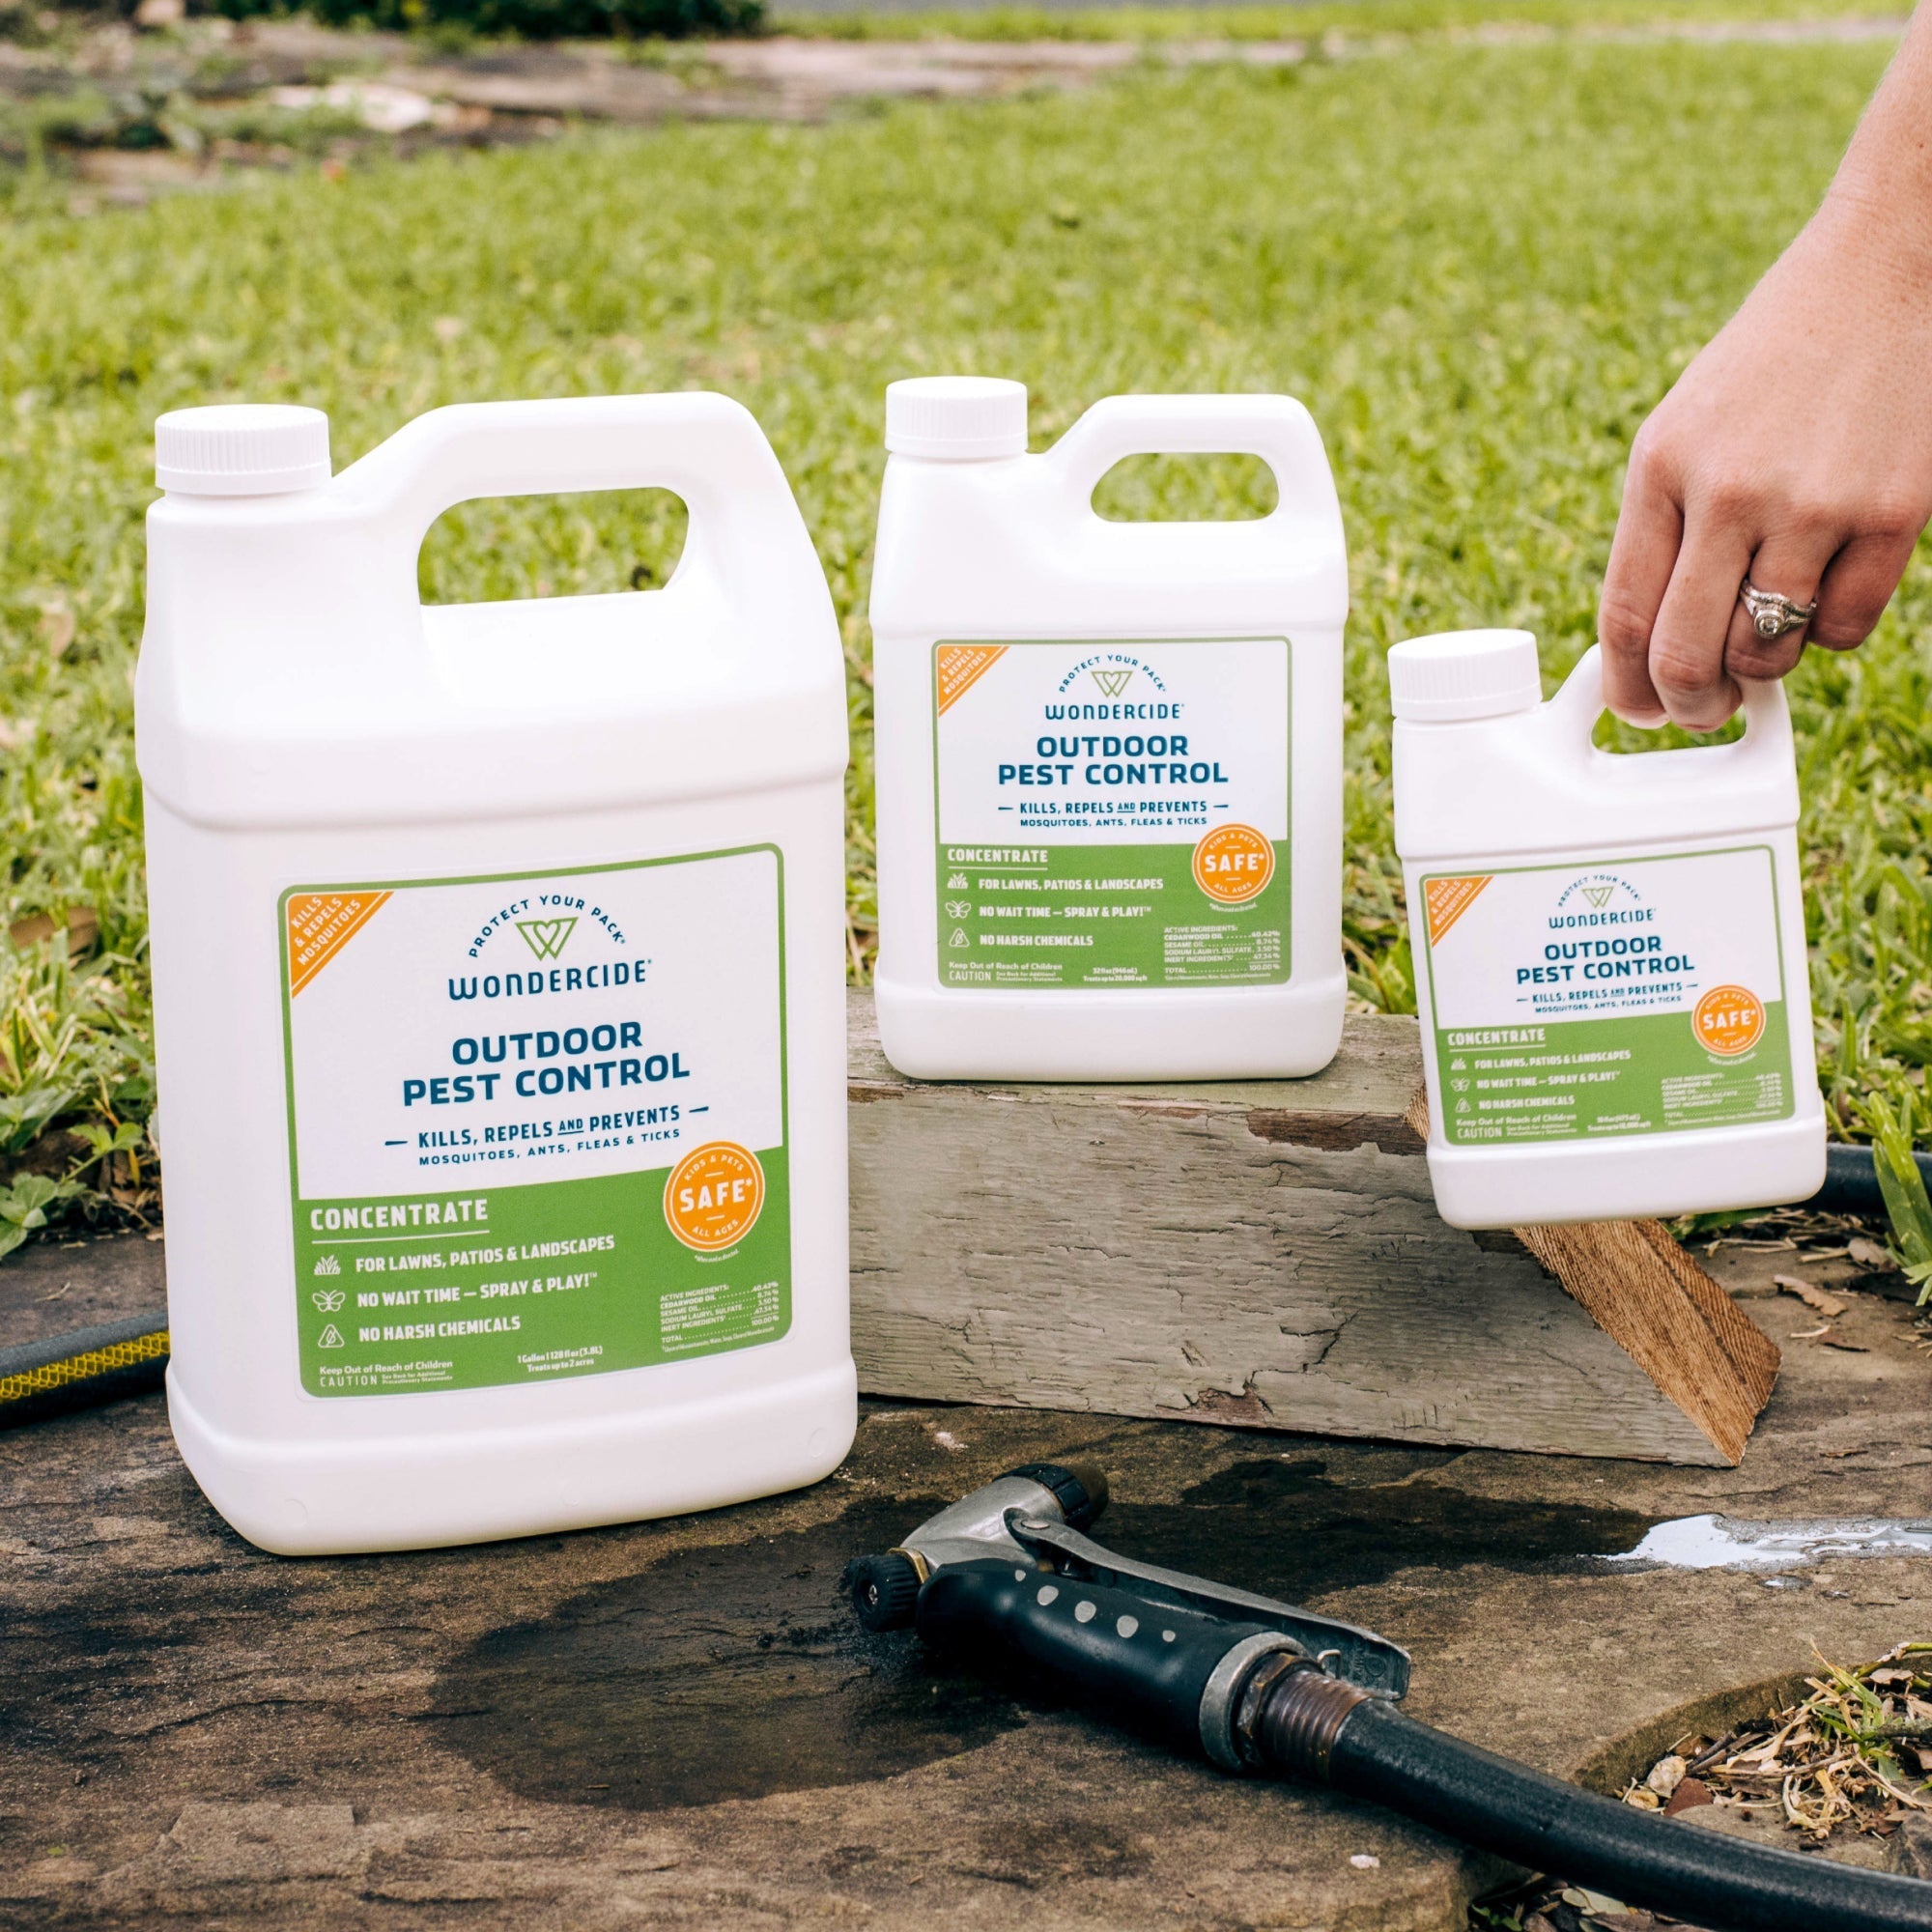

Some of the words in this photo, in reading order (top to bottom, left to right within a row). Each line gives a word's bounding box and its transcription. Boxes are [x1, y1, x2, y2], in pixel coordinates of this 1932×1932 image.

[1059, 656, 1100, 693] PROTECT
[1107, 655, 1138, 666] YOUR
[1037, 735, 1189, 758] OUTDOOR
[999, 764, 1073, 785] PEST
[1085, 762, 1229, 785] CONTROL
[1020, 802, 1061, 815] KILLS,
[1065, 802, 1114, 813] REPELS
[1118, 802, 1135, 810] AND
[1140, 801, 1208, 812] PREVENTS
[1020, 818, 1093, 828] MOSQUITOES,
[1095, 818, 1127, 827] ANTS,
[1131, 817, 1162, 826] FLEAS
[1167, 817, 1173, 826] &
[948, 848, 1048, 863] CONCENTRATE
[979, 879, 999, 890] FOR
[1001, 879, 1041, 891] LAWNS,
[1044, 879, 1082, 890] PATIOS
[1084, 879, 1093, 890] &
[1094, 878, 1163, 890] LANDSCAPES
[1214, 883, 1229, 893] ALL
[291, 896, 323, 928] KILLS
[980, 906, 995, 917] NO
[997, 906, 1023, 917] WAIT
[1025, 906, 1051, 917] TIME
[1065, 906, 1099, 918] SPRAY
[1101, 906, 1110, 917] &
[294, 937, 305, 948] &
[303, 897, 342, 937] REPELS
[469, 899, 529, 958] PROTECT
[539, 895, 585, 910] YOUR
[298, 899, 360, 965] MOSQUITOES
[980, 935, 995, 945] NO
[997, 935, 1033, 945] HARSH
[1035, 935, 1094, 946] CHEMICALS
[1545, 935, 1662, 961] OUTDOOR
[950, 971, 991, 980] CAUTION
[1517, 965, 1575, 984] PEST
[1584, 954, 1694, 980] CONTROL
[1532, 992, 1566, 1003] KILLS,
[1569, 989, 1607, 1001] REPELS
[1629, 981, 1682, 995] PREVENTS
[1659, 995, 1682, 1004] TICKS
[452, 1021, 642, 1065] OUTDOOR
[1447, 1028, 1546, 1046] CONCENTRATE
[1475, 1060, 1492, 1069] FOR
[1494, 1057, 1528, 1068] LAWNS,
[1530, 1054, 1562, 1066] PATIOS
[1572, 1050, 1631, 1064] LANDSCAPES
[404, 1073, 500, 1107] PEST
[516, 1053, 690, 1096] CONTROL
[1477, 1079, 1490, 1089] NO
[1492, 1077, 1514, 1088] WAIT
[1516, 1076, 1537, 1087] TIME
[1548, 1073, 1577, 1085] SPRAY
[1479, 1099, 1492, 1110] NO
[1493, 1097, 1523, 1109] HARSH
[1524, 1094, 1575, 1107] CHEMICALS
[419, 1128, 478, 1148] KILLS,
[485, 1122, 553, 1144] REPELS
[558, 1119, 583, 1132] AND
[589, 1105, 680, 1131] PREVENTS
[1457, 1118, 1476, 1127] Keep
[1506, 1116, 1530, 1124] Reach
[1457, 1126, 1501, 1139] CAUTION
[419, 1149, 521, 1165] MOSQUITOES,
[527, 1144, 570, 1156] ANTS,
[578, 1137, 620, 1151] FLEAS
[626, 1136, 634, 1145] &
[641, 1129, 680, 1142] TICKS
[684, 1159, 706, 1180] KIDS
[721, 1154, 744, 1171] PETS
[310, 1199, 488, 1231] CONCENTRATE
[692, 1226, 710, 1236] ALL
[715, 1219, 738, 1236] AGES
[355, 1258, 385, 1273] FOR
[389, 1253, 446, 1271] LAWNS,
[450, 1247, 503, 1266] PATIOS
[506, 1246, 518, 1262] &
[522, 1235, 614, 1260] LANDSCAPES
[357, 1293, 379, 1308] NO
[383, 1290, 420, 1306] WAIT
[424, 1287, 460, 1303] TIME
[480, 1280, 528, 1299] SPRAY
[531, 1278, 543, 1293] &
[661, 1292, 684, 1302] ACTIVE
[661, 1297, 703, 1310] CEDARWOOD
[661, 1308, 687, 1317] SESAME
[661, 1316, 687, 1324] SODIUM
[715, 1304, 742, 1316] SULFATE
[359, 1327, 381, 1342] NO
[384, 1323, 435, 1341] HARSH
[439, 1316, 521, 1337] CHEMICALS
[662, 1322, 680, 1332] INERT
[662, 1335, 683, 1344] TOTAL
[522, 1353, 545, 1363] Gallon
[551, 1350, 564, 1359] 128
[320, 1366, 342, 1376] Keep
[363, 1364, 373, 1374] of
[375, 1363, 402, 1373] Reach
[405, 1362, 413, 1371] of
[415, 1360, 453, 1370] Children
[552, 1362, 560, 1371] up
[320, 1376, 378, 1387] CAUTION
